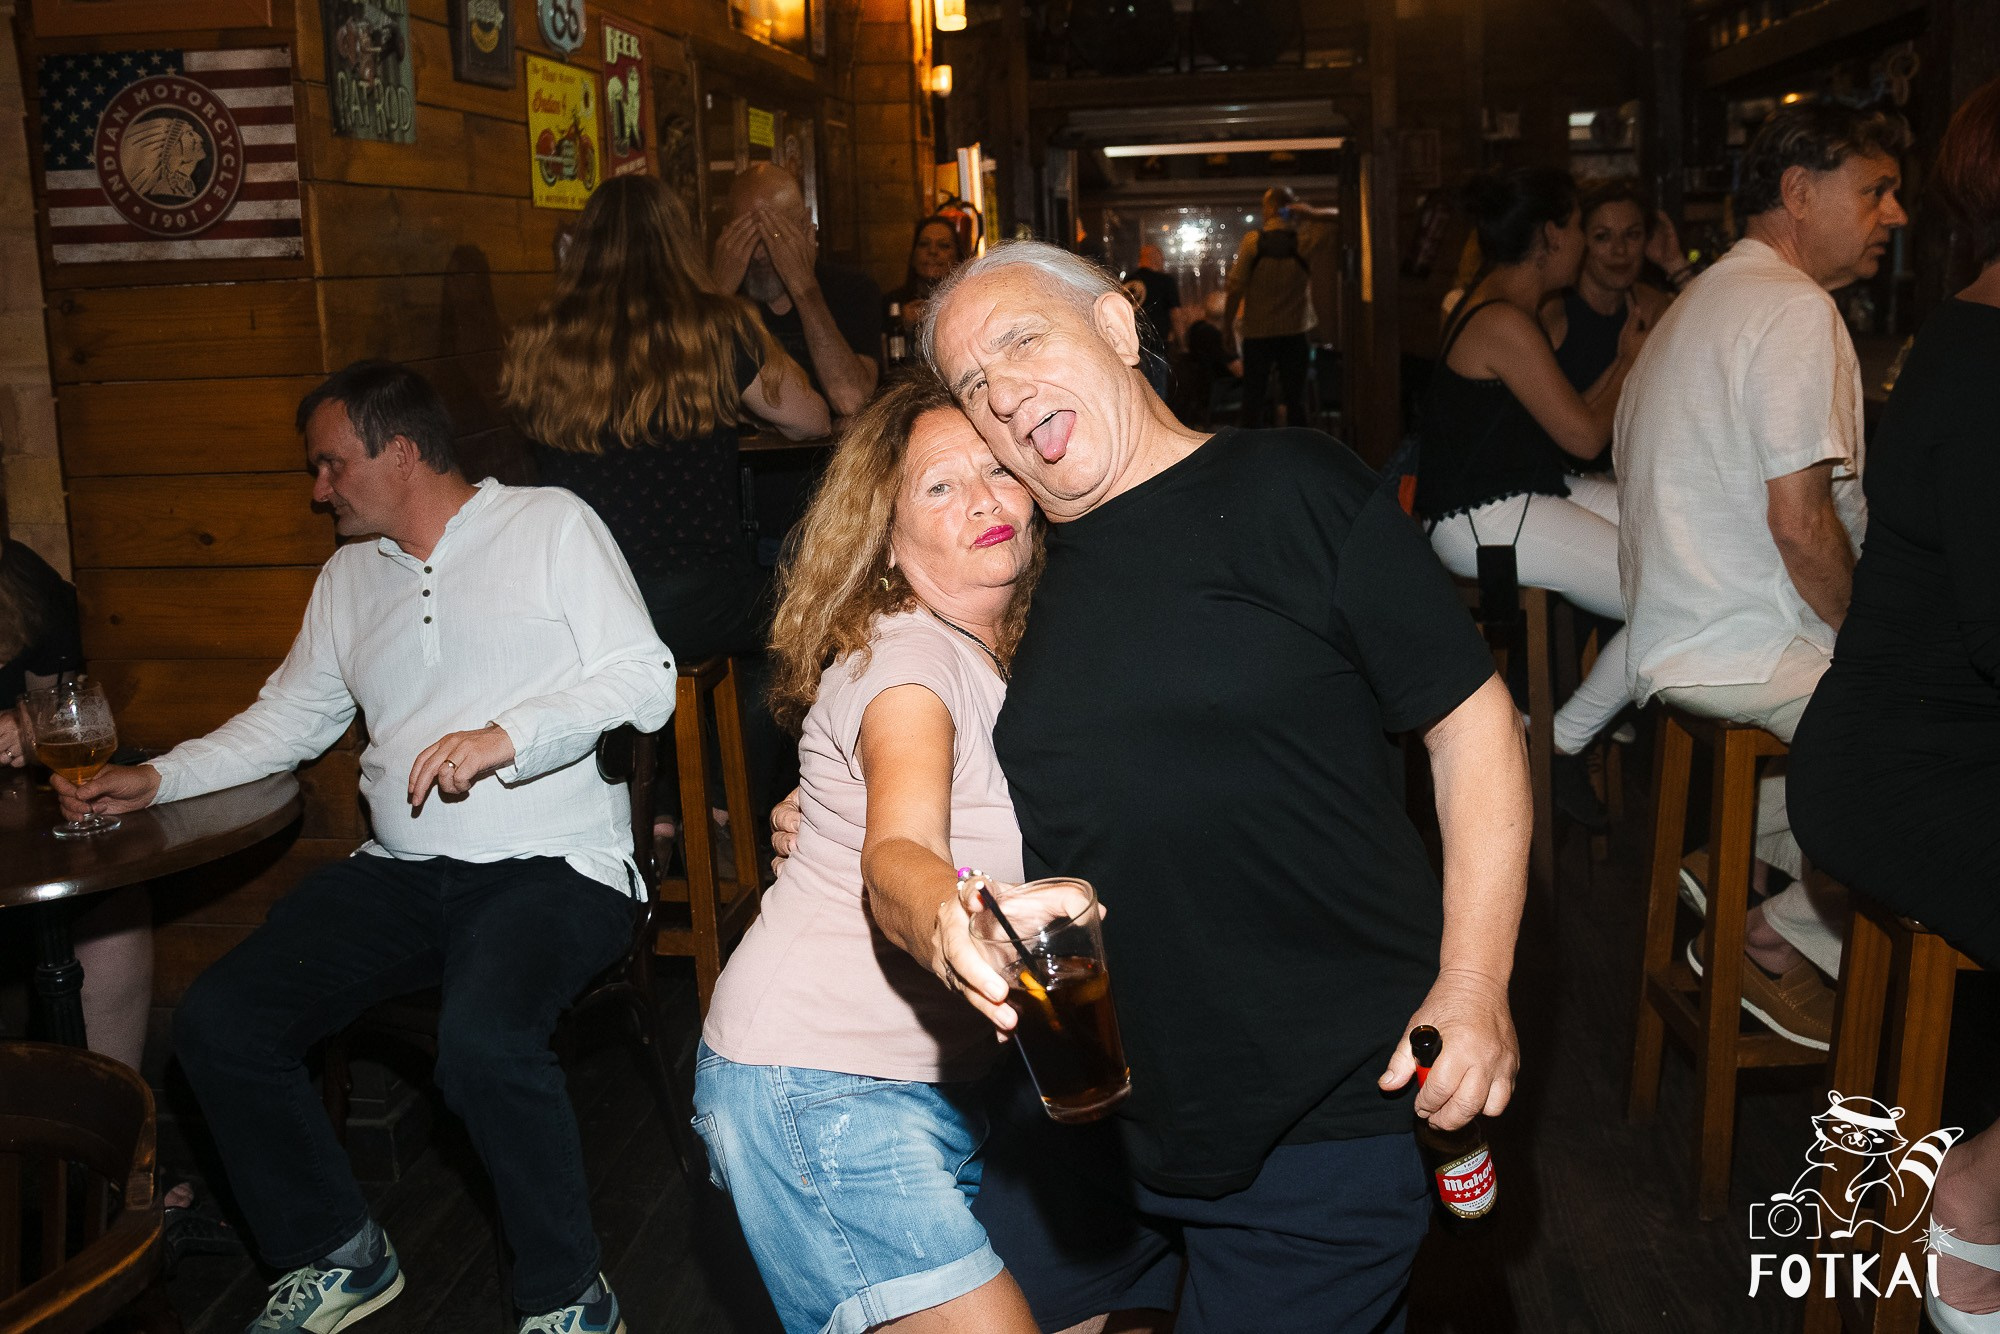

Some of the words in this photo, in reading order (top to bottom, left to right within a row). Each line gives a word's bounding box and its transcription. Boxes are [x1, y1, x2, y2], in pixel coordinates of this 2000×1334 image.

[552, 0, 580, 39] 66
[605, 25, 642, 65] BEER
[337, 70, 371, 131] RAT
[374, 77, 412, 136] ROD
[103, 105, 130, 203] INDIAN
[133, 84, 236, 200] MOTORCYCLE
[151, 210, 200, 229] 1901
